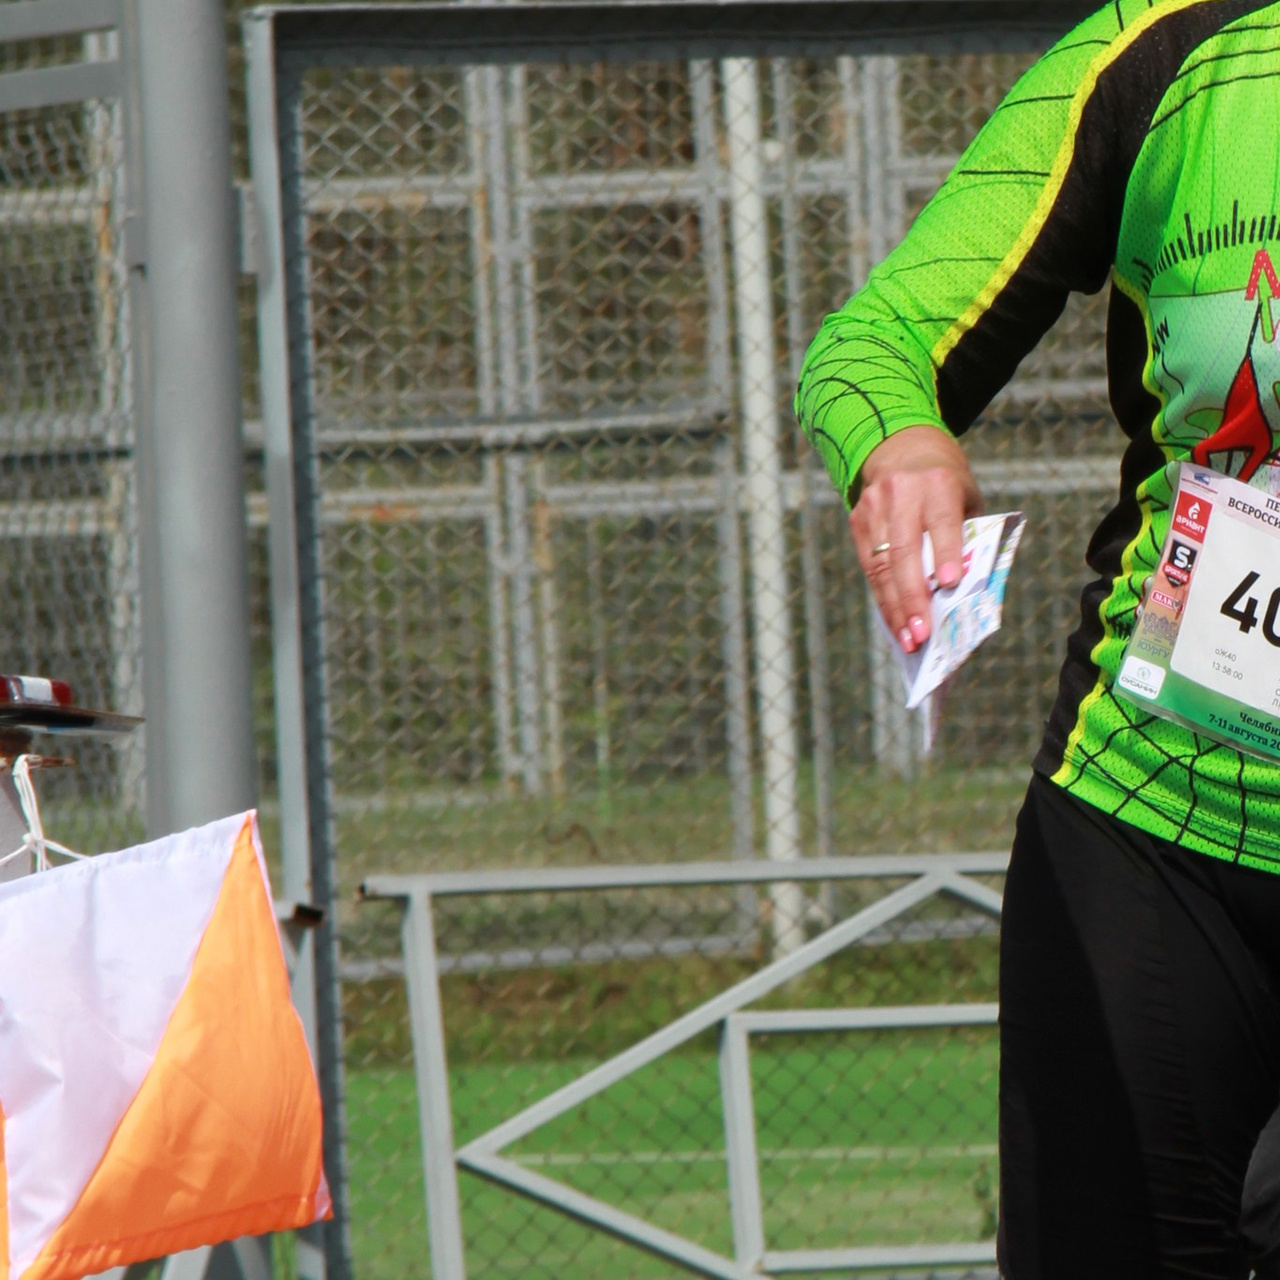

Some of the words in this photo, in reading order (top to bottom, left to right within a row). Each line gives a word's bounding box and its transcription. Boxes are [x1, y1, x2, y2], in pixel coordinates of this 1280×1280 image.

[1211, 661, 1244, 681] 13:58:00
[1208, 713, 1227, 729] 7-11
[1228, 723, 1268, 746] августа
